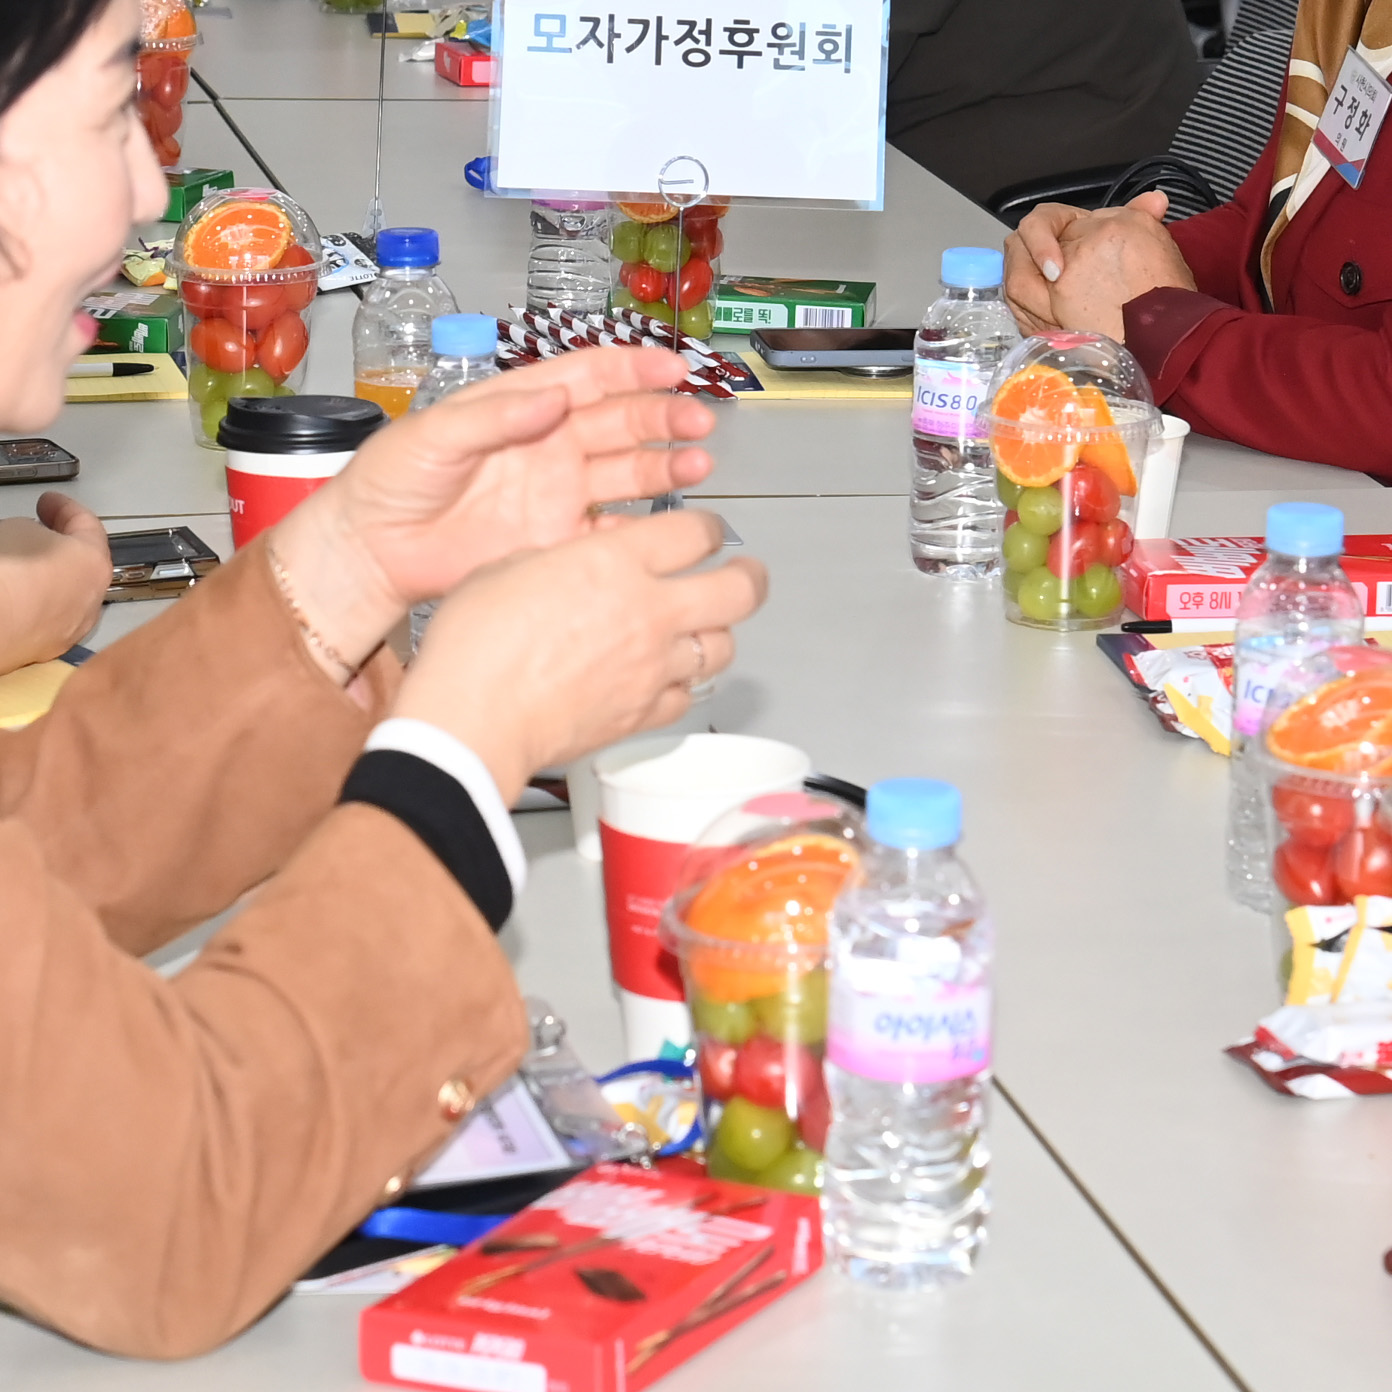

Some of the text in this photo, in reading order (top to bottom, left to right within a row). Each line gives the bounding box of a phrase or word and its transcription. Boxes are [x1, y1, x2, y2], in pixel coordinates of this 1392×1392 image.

[526, 12, 854, 75] 모자가정후원회
[1333, 84, 1372, 142] 구정화
[1178, 591, 1204, 611] 오후
